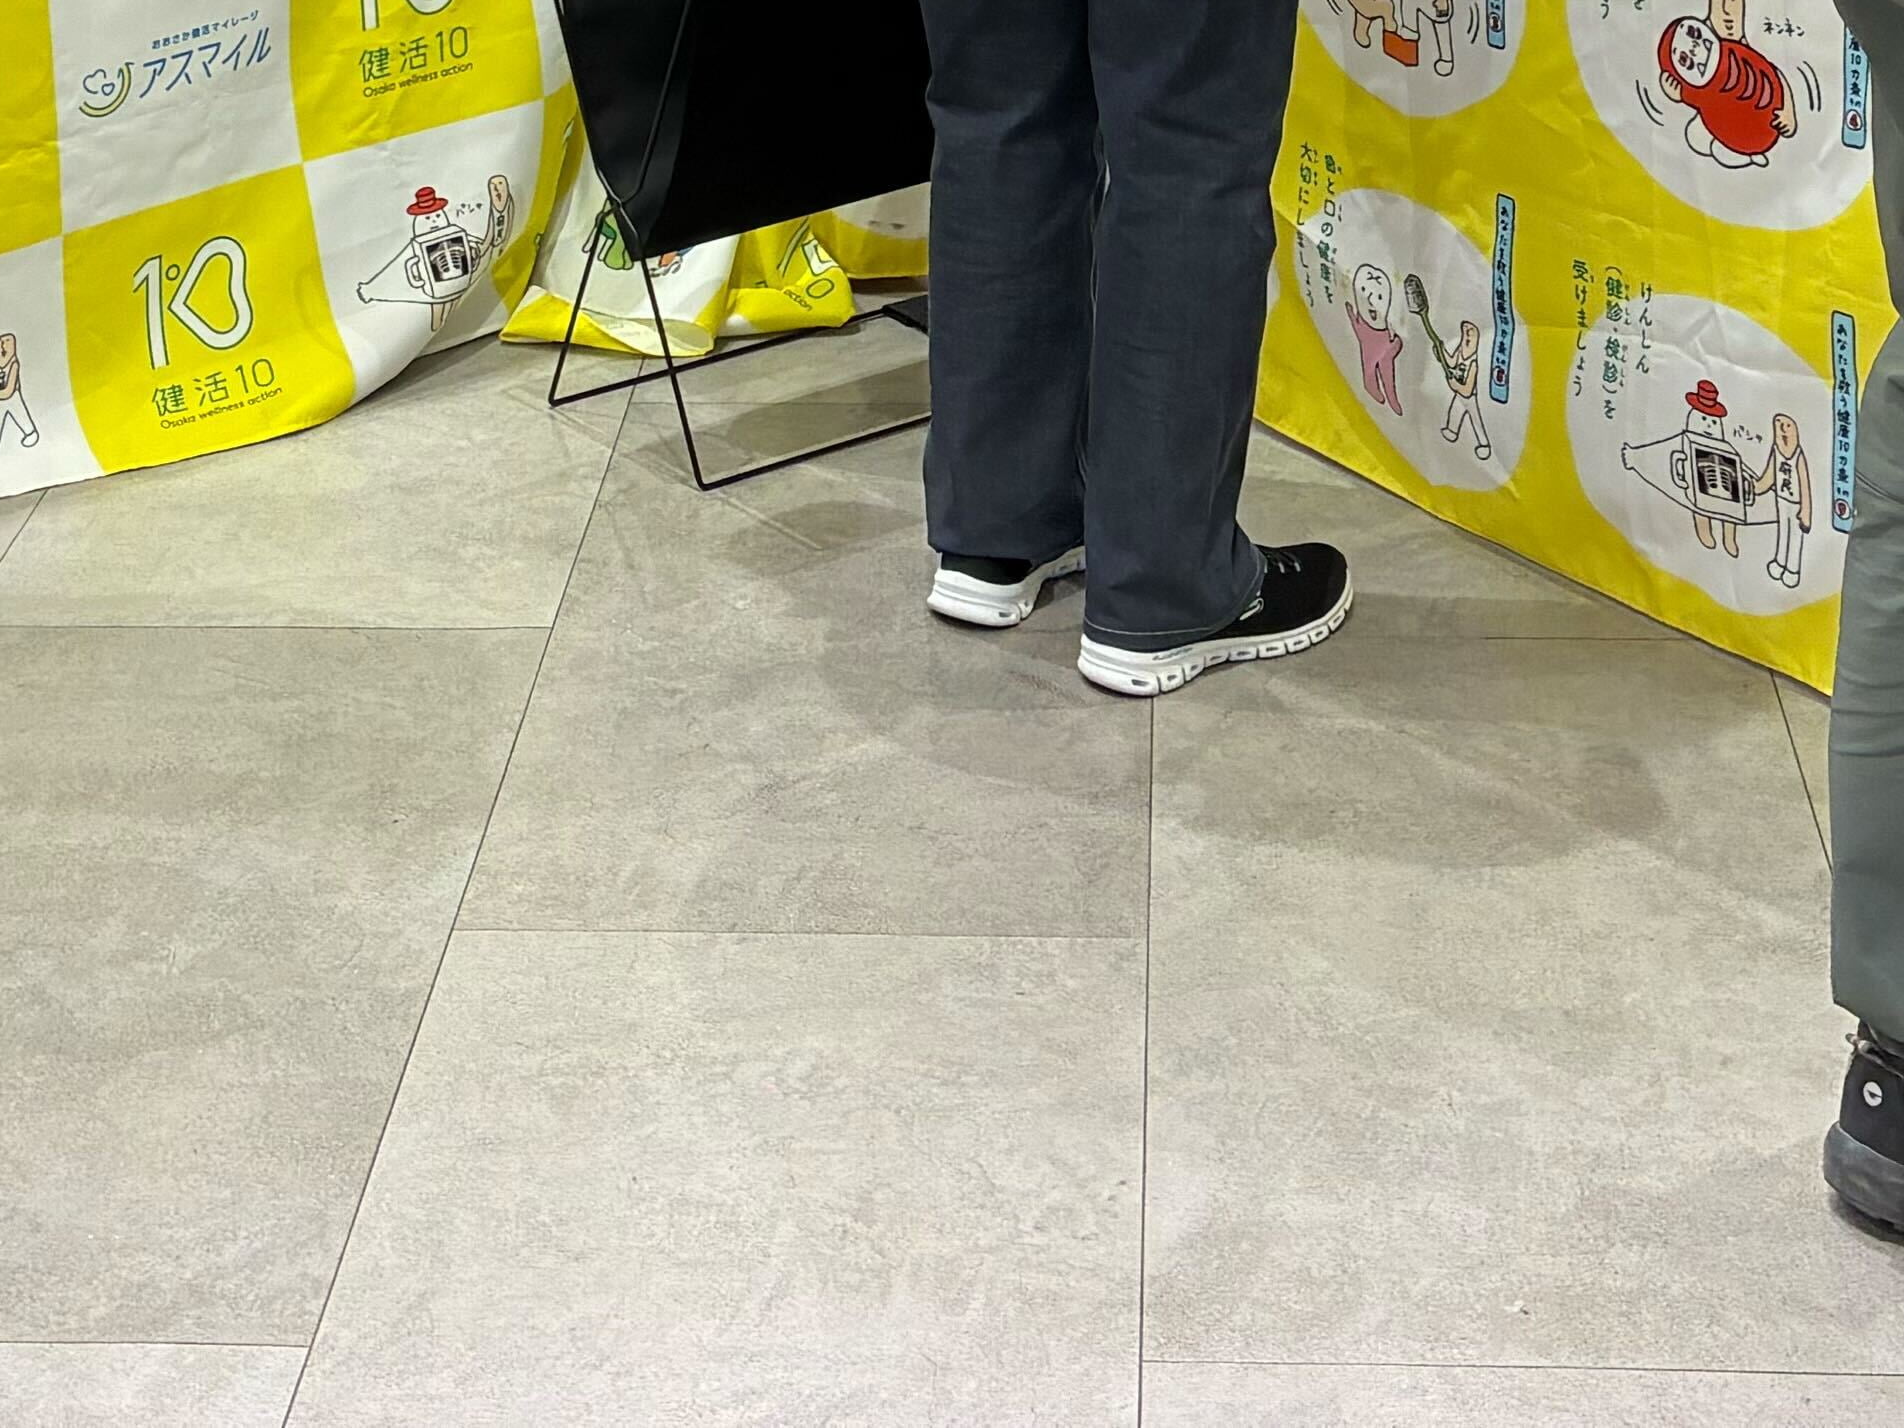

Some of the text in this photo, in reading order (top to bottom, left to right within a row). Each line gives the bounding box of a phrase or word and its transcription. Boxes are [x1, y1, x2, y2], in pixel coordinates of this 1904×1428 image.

[150, 9, 260, 51] おおさか健活マイレージ
[358, 25, 470, 84] 健活10
[1762, 16, 1806, 38] ネンネン
[139, 26, 272, 99] アスマイル
[362, 62, 474, 99] Osaka wellness action
[1572, 259, 1590, 397] 受けましょう
[1636, 282, 1653, 374] けんしん
[151, 357, 276, 418] 健活10
[159, 386, 283, 431] Osaka wellness action
